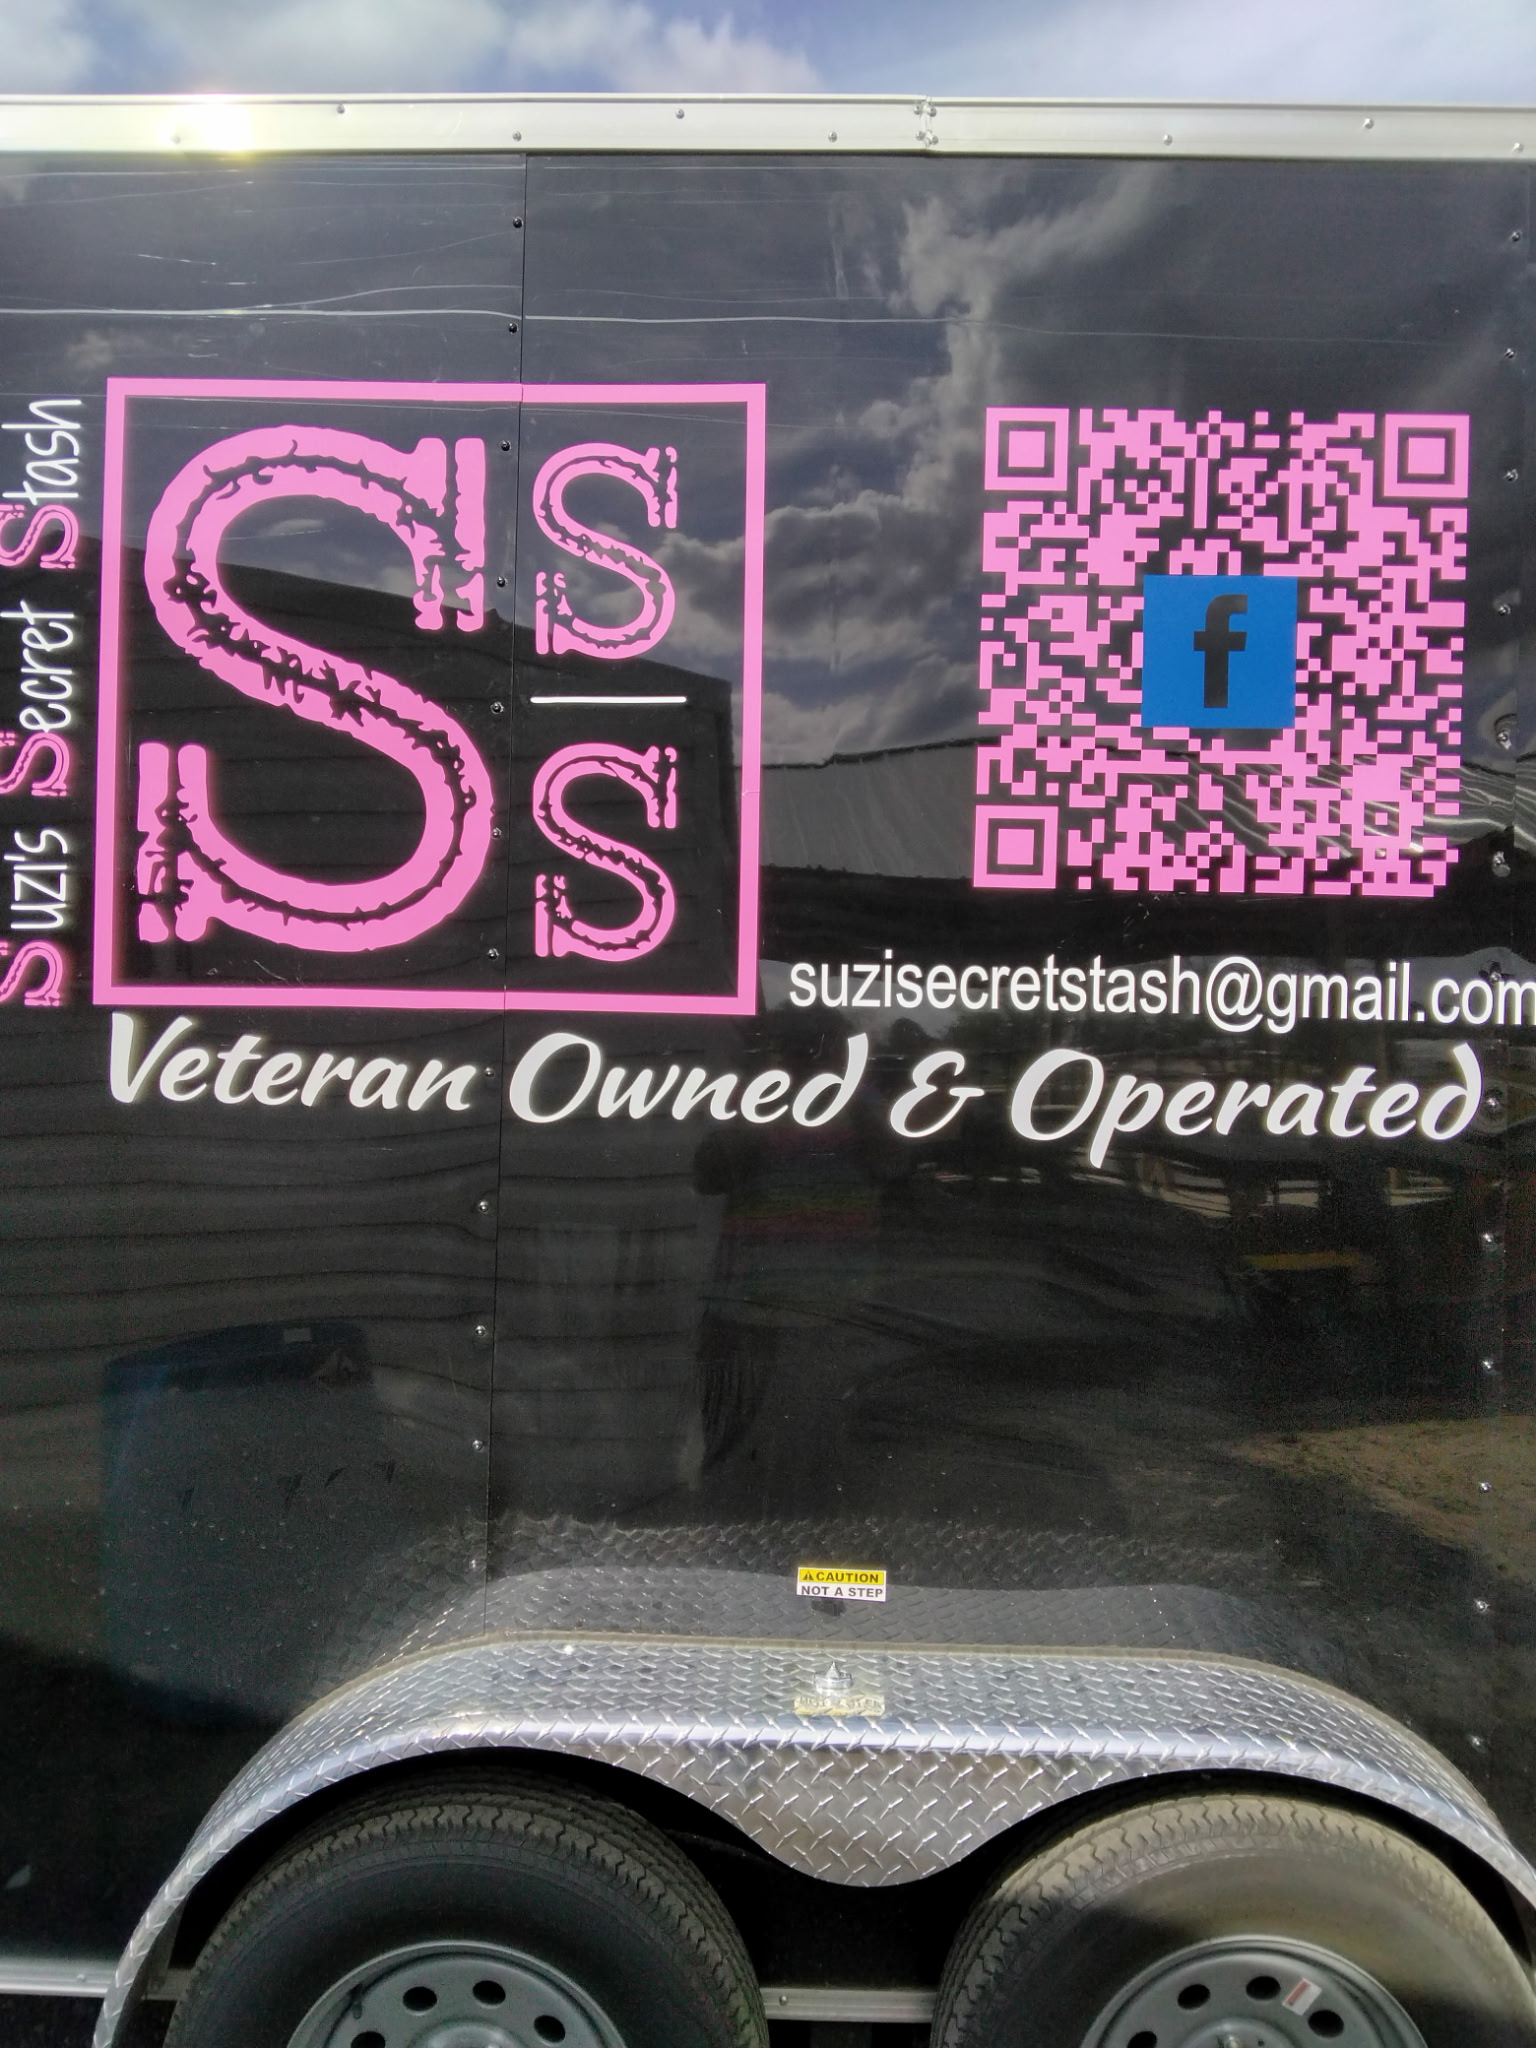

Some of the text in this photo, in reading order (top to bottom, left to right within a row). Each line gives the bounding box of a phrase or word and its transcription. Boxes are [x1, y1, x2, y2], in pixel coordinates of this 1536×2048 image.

[0, 399, 82, 569] Stash
[533, 442, 678, 660] S
[0, 601, 74, 797] Secret
[137, 424, 494, 953] S
[1193, 593, 1248, 708] f
[533, 742, 678, 962] S
[789, 949, 1536, 1034] suzisecretstash@gmail.com
[110, 1012, 1482, 1169] Veteran Owned & Operated
[801, 1585, 883, 1598] NOT A STEP
[816, 1571, 879, 1583] CAUTION
